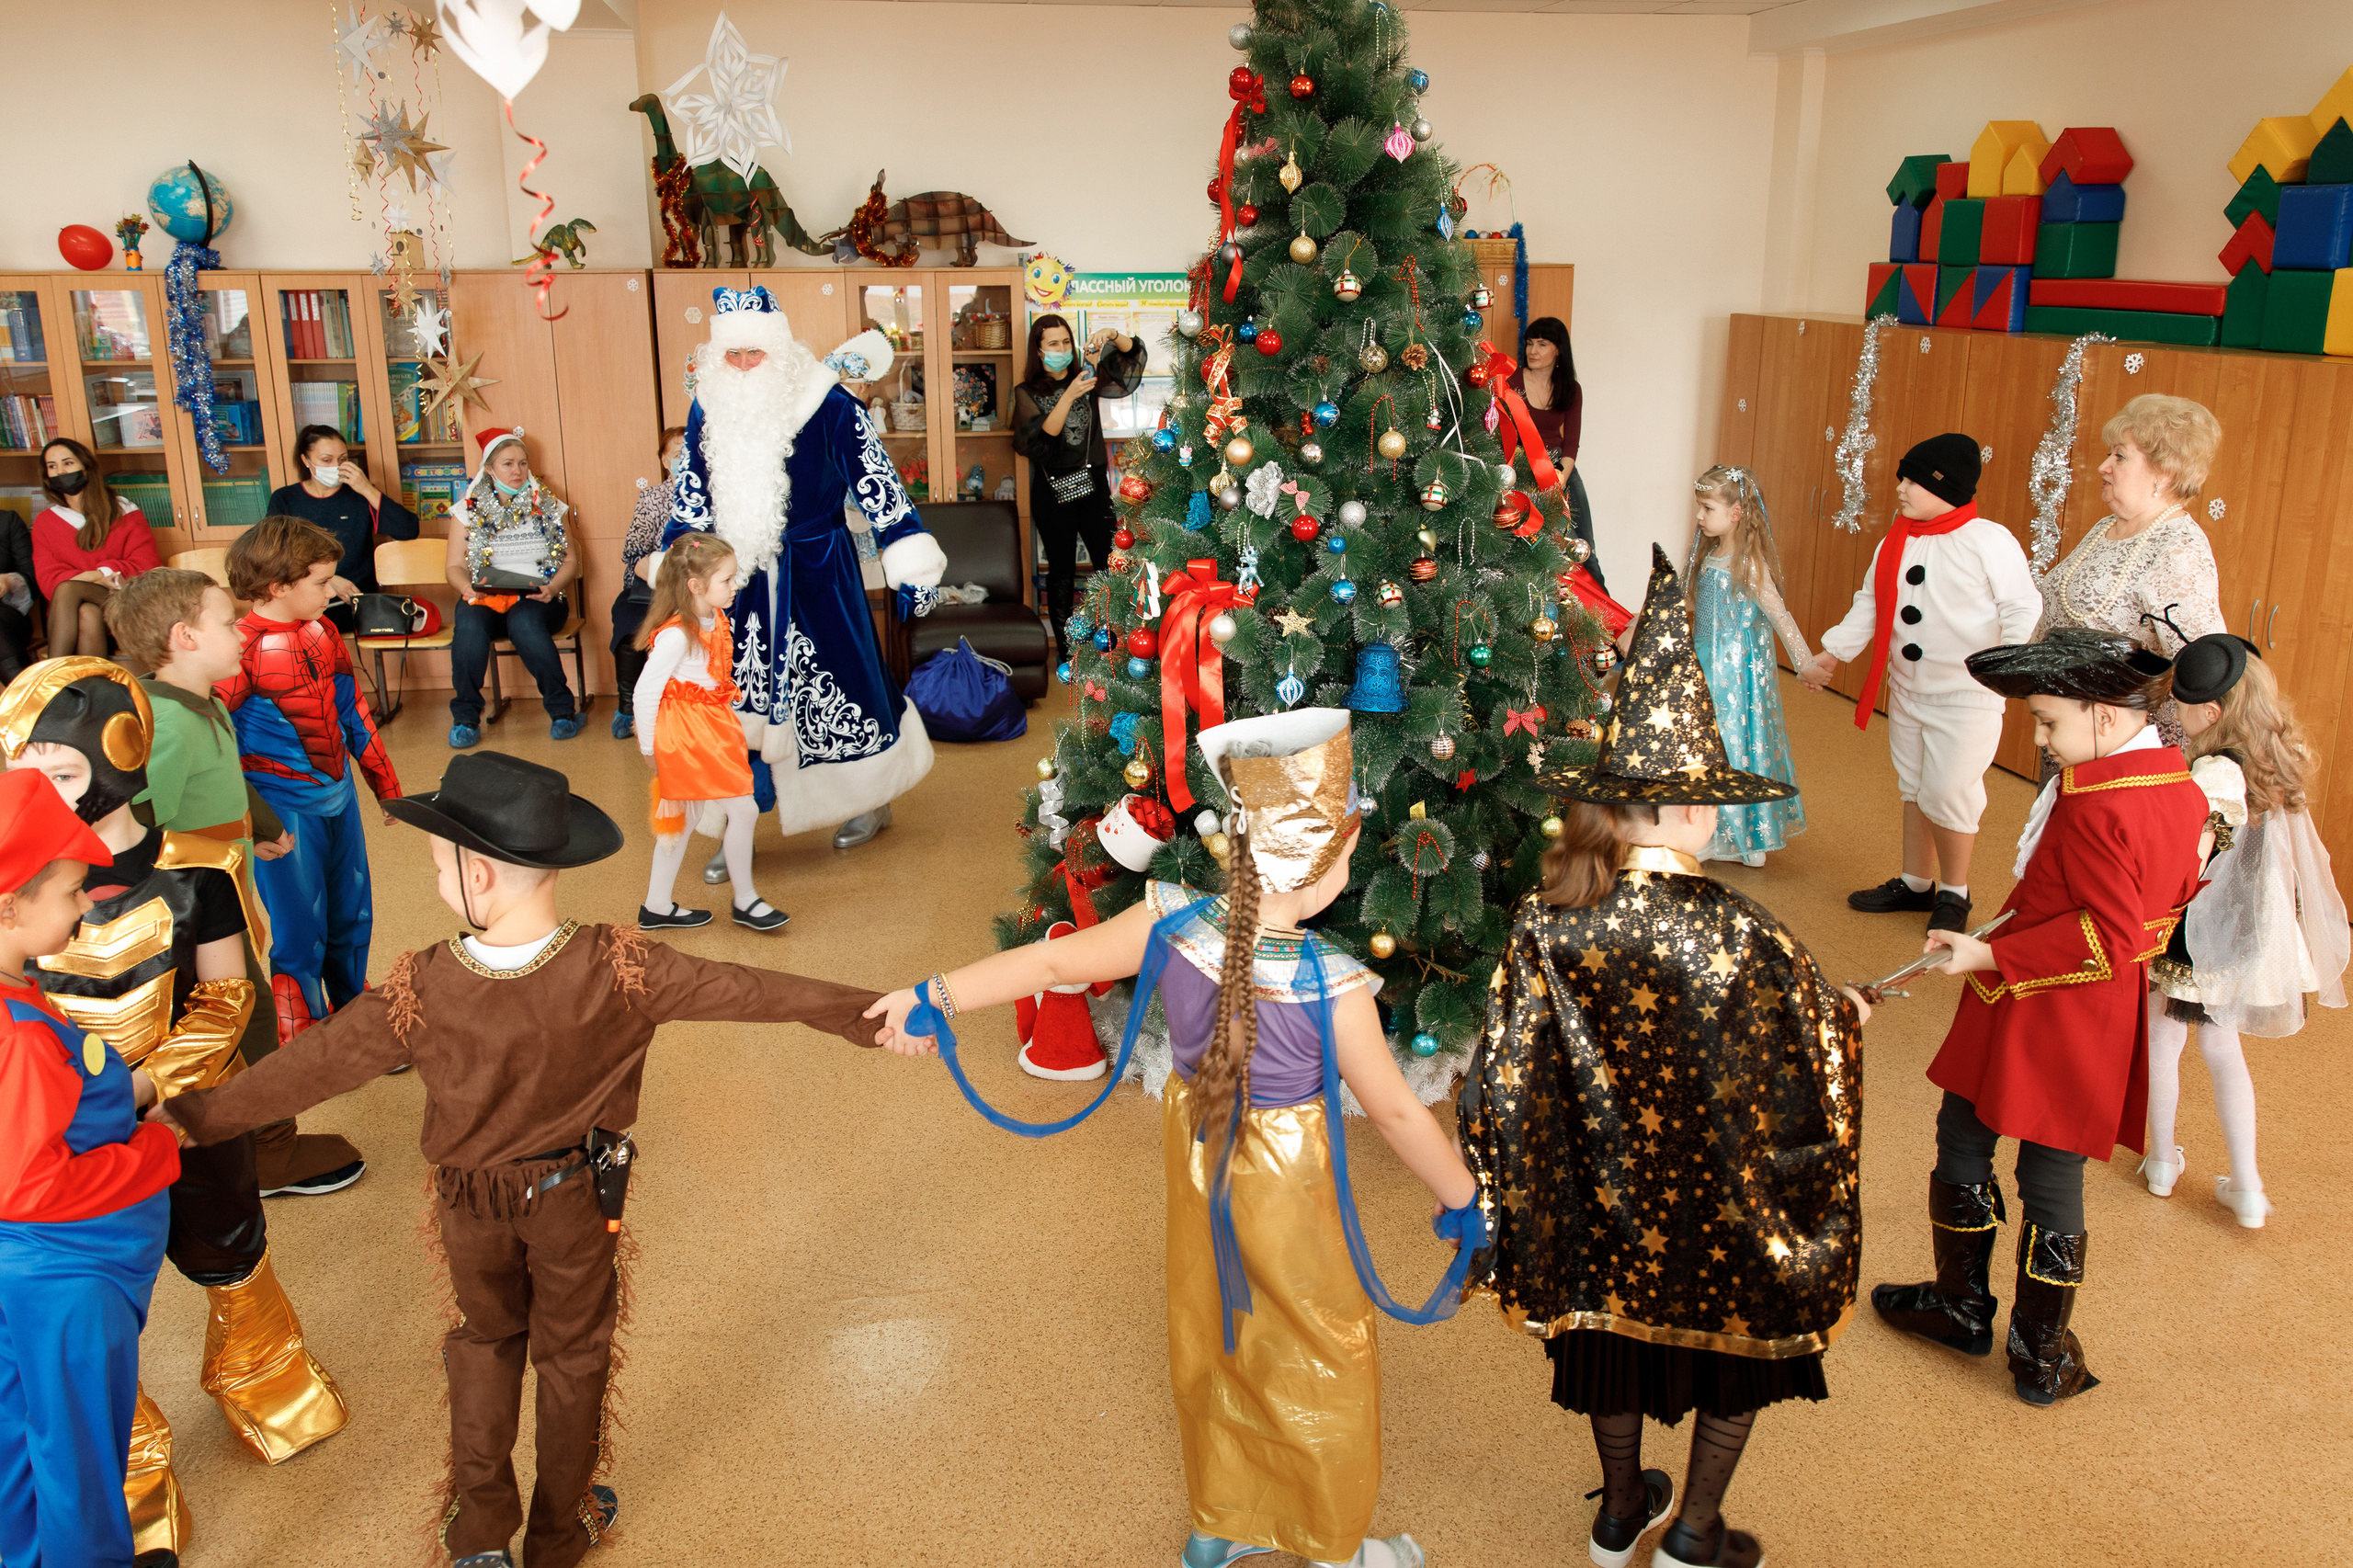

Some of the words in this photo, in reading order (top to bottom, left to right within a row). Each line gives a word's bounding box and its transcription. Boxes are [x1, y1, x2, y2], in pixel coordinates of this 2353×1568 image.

[1069, 277, 1136, 293] ЛАССНЫЙ
[1138, 279, 1191, 293] УГОЛОК
[415, 468, 465, 476] СВЕТОФОР
